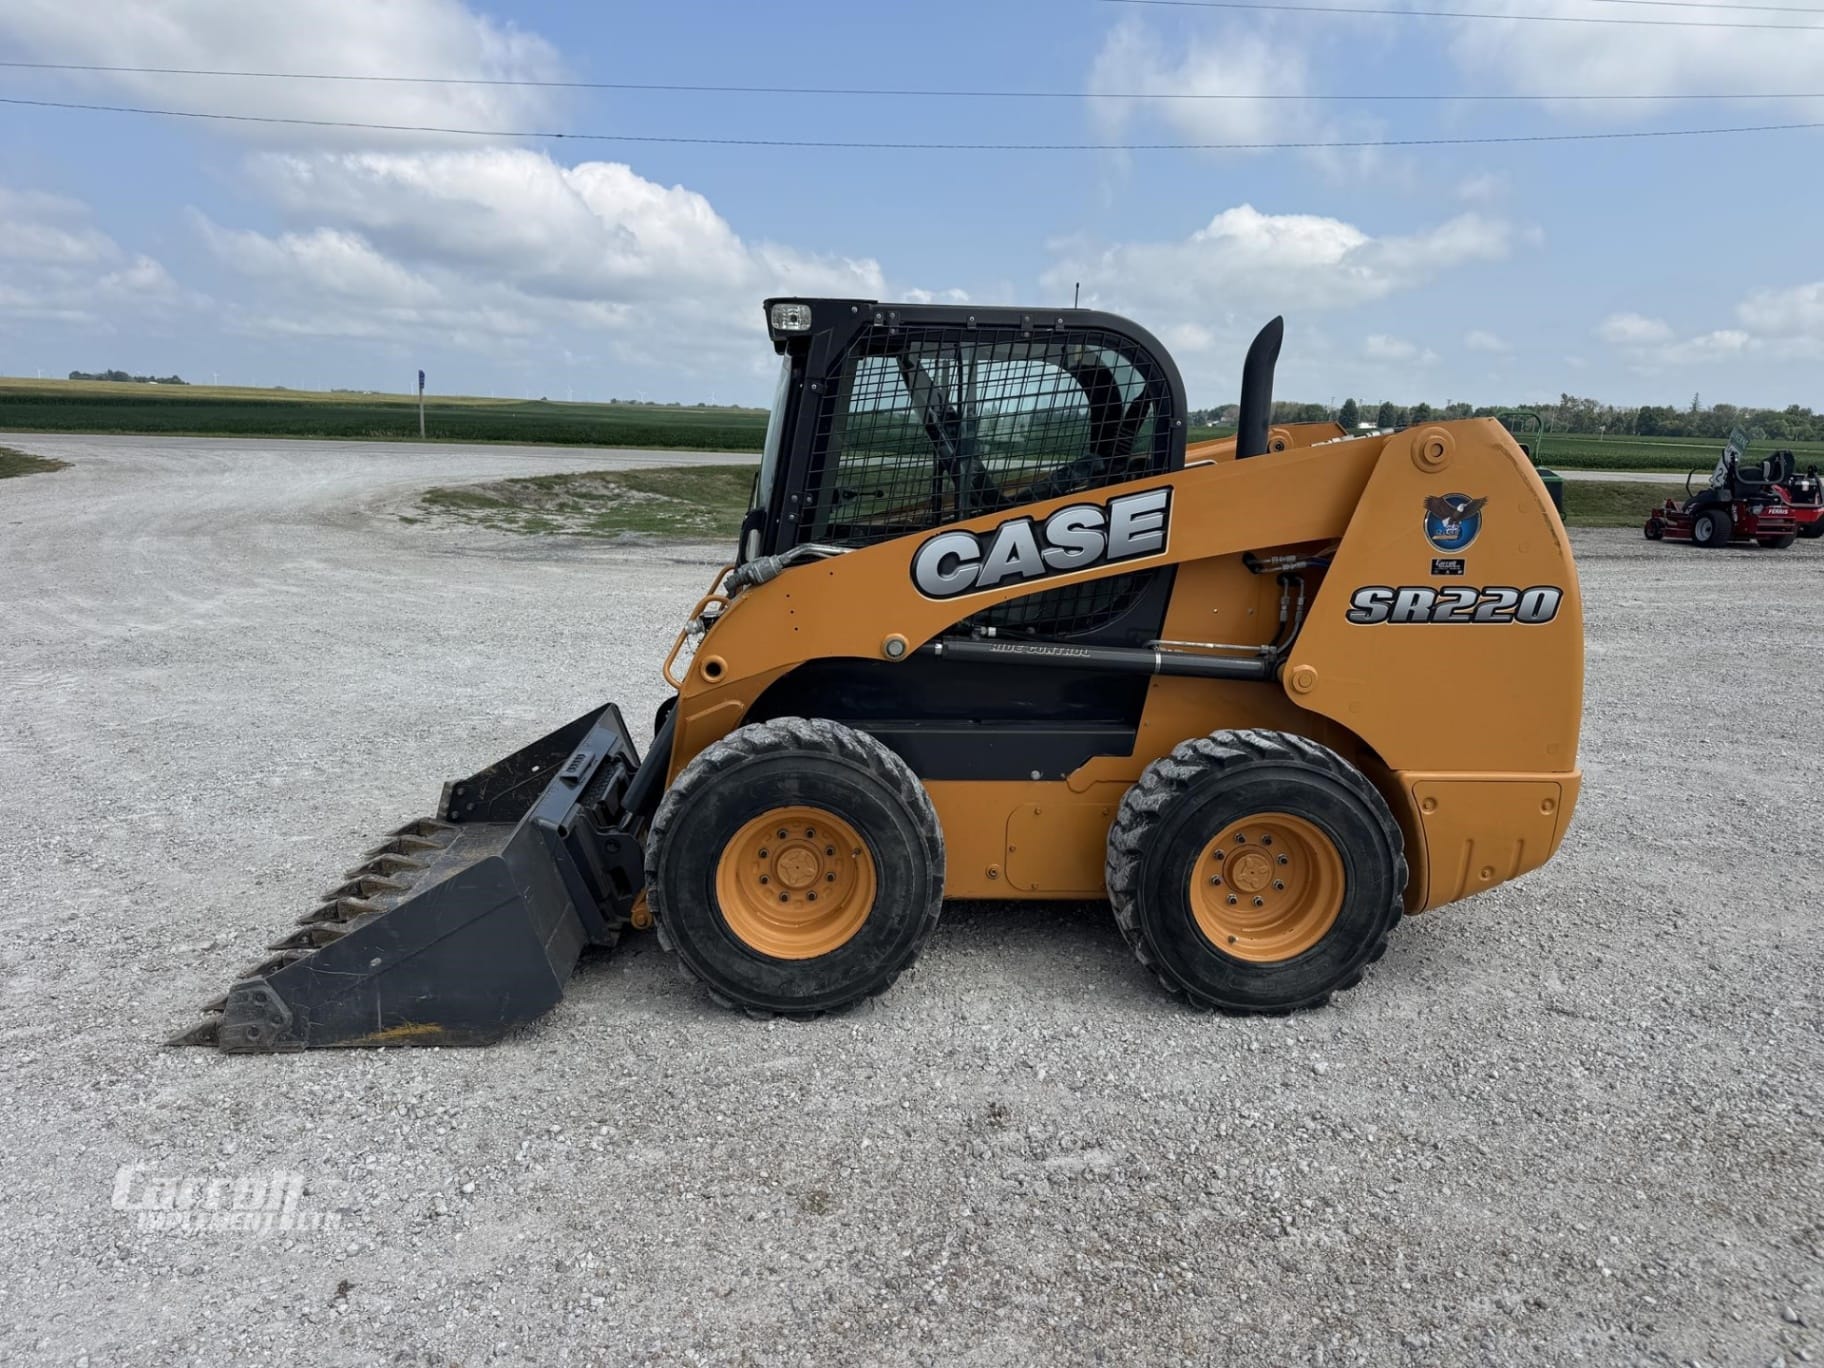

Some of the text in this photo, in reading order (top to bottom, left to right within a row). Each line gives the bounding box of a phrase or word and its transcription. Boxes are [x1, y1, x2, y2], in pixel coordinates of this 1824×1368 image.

[912, 487, 1171, 598] CASE
[1347, 586, 1562, 625] SR220
[990, 643, 1091, 658] RIDE CONTROL
